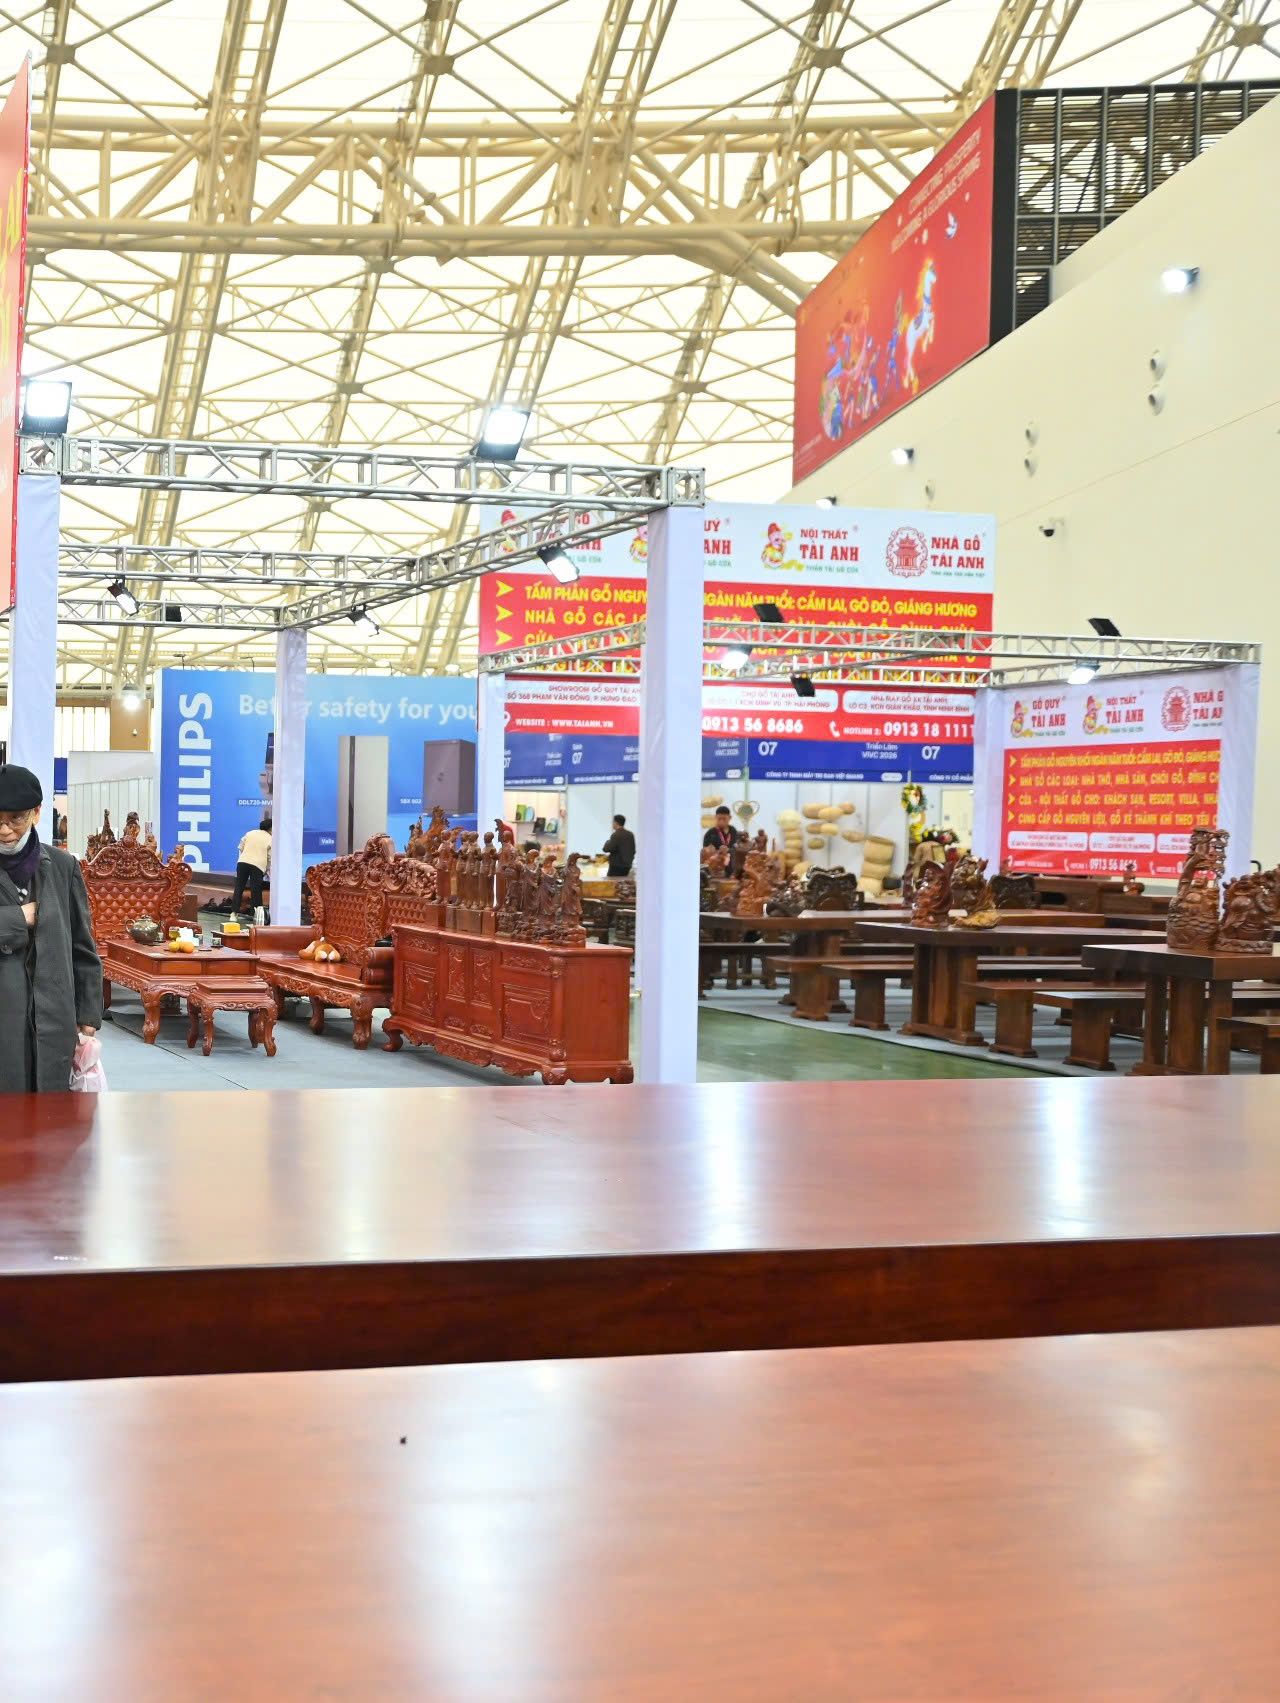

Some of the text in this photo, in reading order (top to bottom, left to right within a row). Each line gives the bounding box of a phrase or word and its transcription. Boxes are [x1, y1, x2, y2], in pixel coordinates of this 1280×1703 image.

[821, 527, 848, 540] THẤT
[800, 541, 859, 561] TÀI ANH
[931, 535, 981, 551] NHÀ GỖ
[931, 554, 984, 569] TÀI ANH
[525, 580, 552, 600] TẤM
[554, 583, 589, 601] PHẢN
[591, 583, 613, 603] GỖ
[735, 591, 763, 607] NĂM
[797, 590, 826, 611] CẨM
[827, 598, 848, 614] LAI,
[894, 598, 933, 616] GIÁNG
[935, 602, 977, 617] HƯƠNG
[525, 607, 556, 625] NHÀ
[563, 606, 587, 625] GỖ
[593, 608, 626, 626] CÁC
[1032, 696, 1043, 710] GỖ
[320, 699, 391, 724] safety
[398, 699, 431, 720] for
[1031, 712, 1045, 728] TÀI
[1049, 713, 1066, 727] ANH
[1106, 706, 1121, 724] TÀI
[1125, 709, 1144, 722] ANH
[515, 718, 545, 727] WEBSITE
[702, 716, 804, 733] 0913 56 8686
[843, 727, 873, 736] HOTLINE
[883, 721, 918, 737] 0913
[923, 723, 940, 737] 18
[758, 741, 778, 756] 07
[921, 746, 940, 760] 07
[178, 692, 213, 871] PHILIPS
